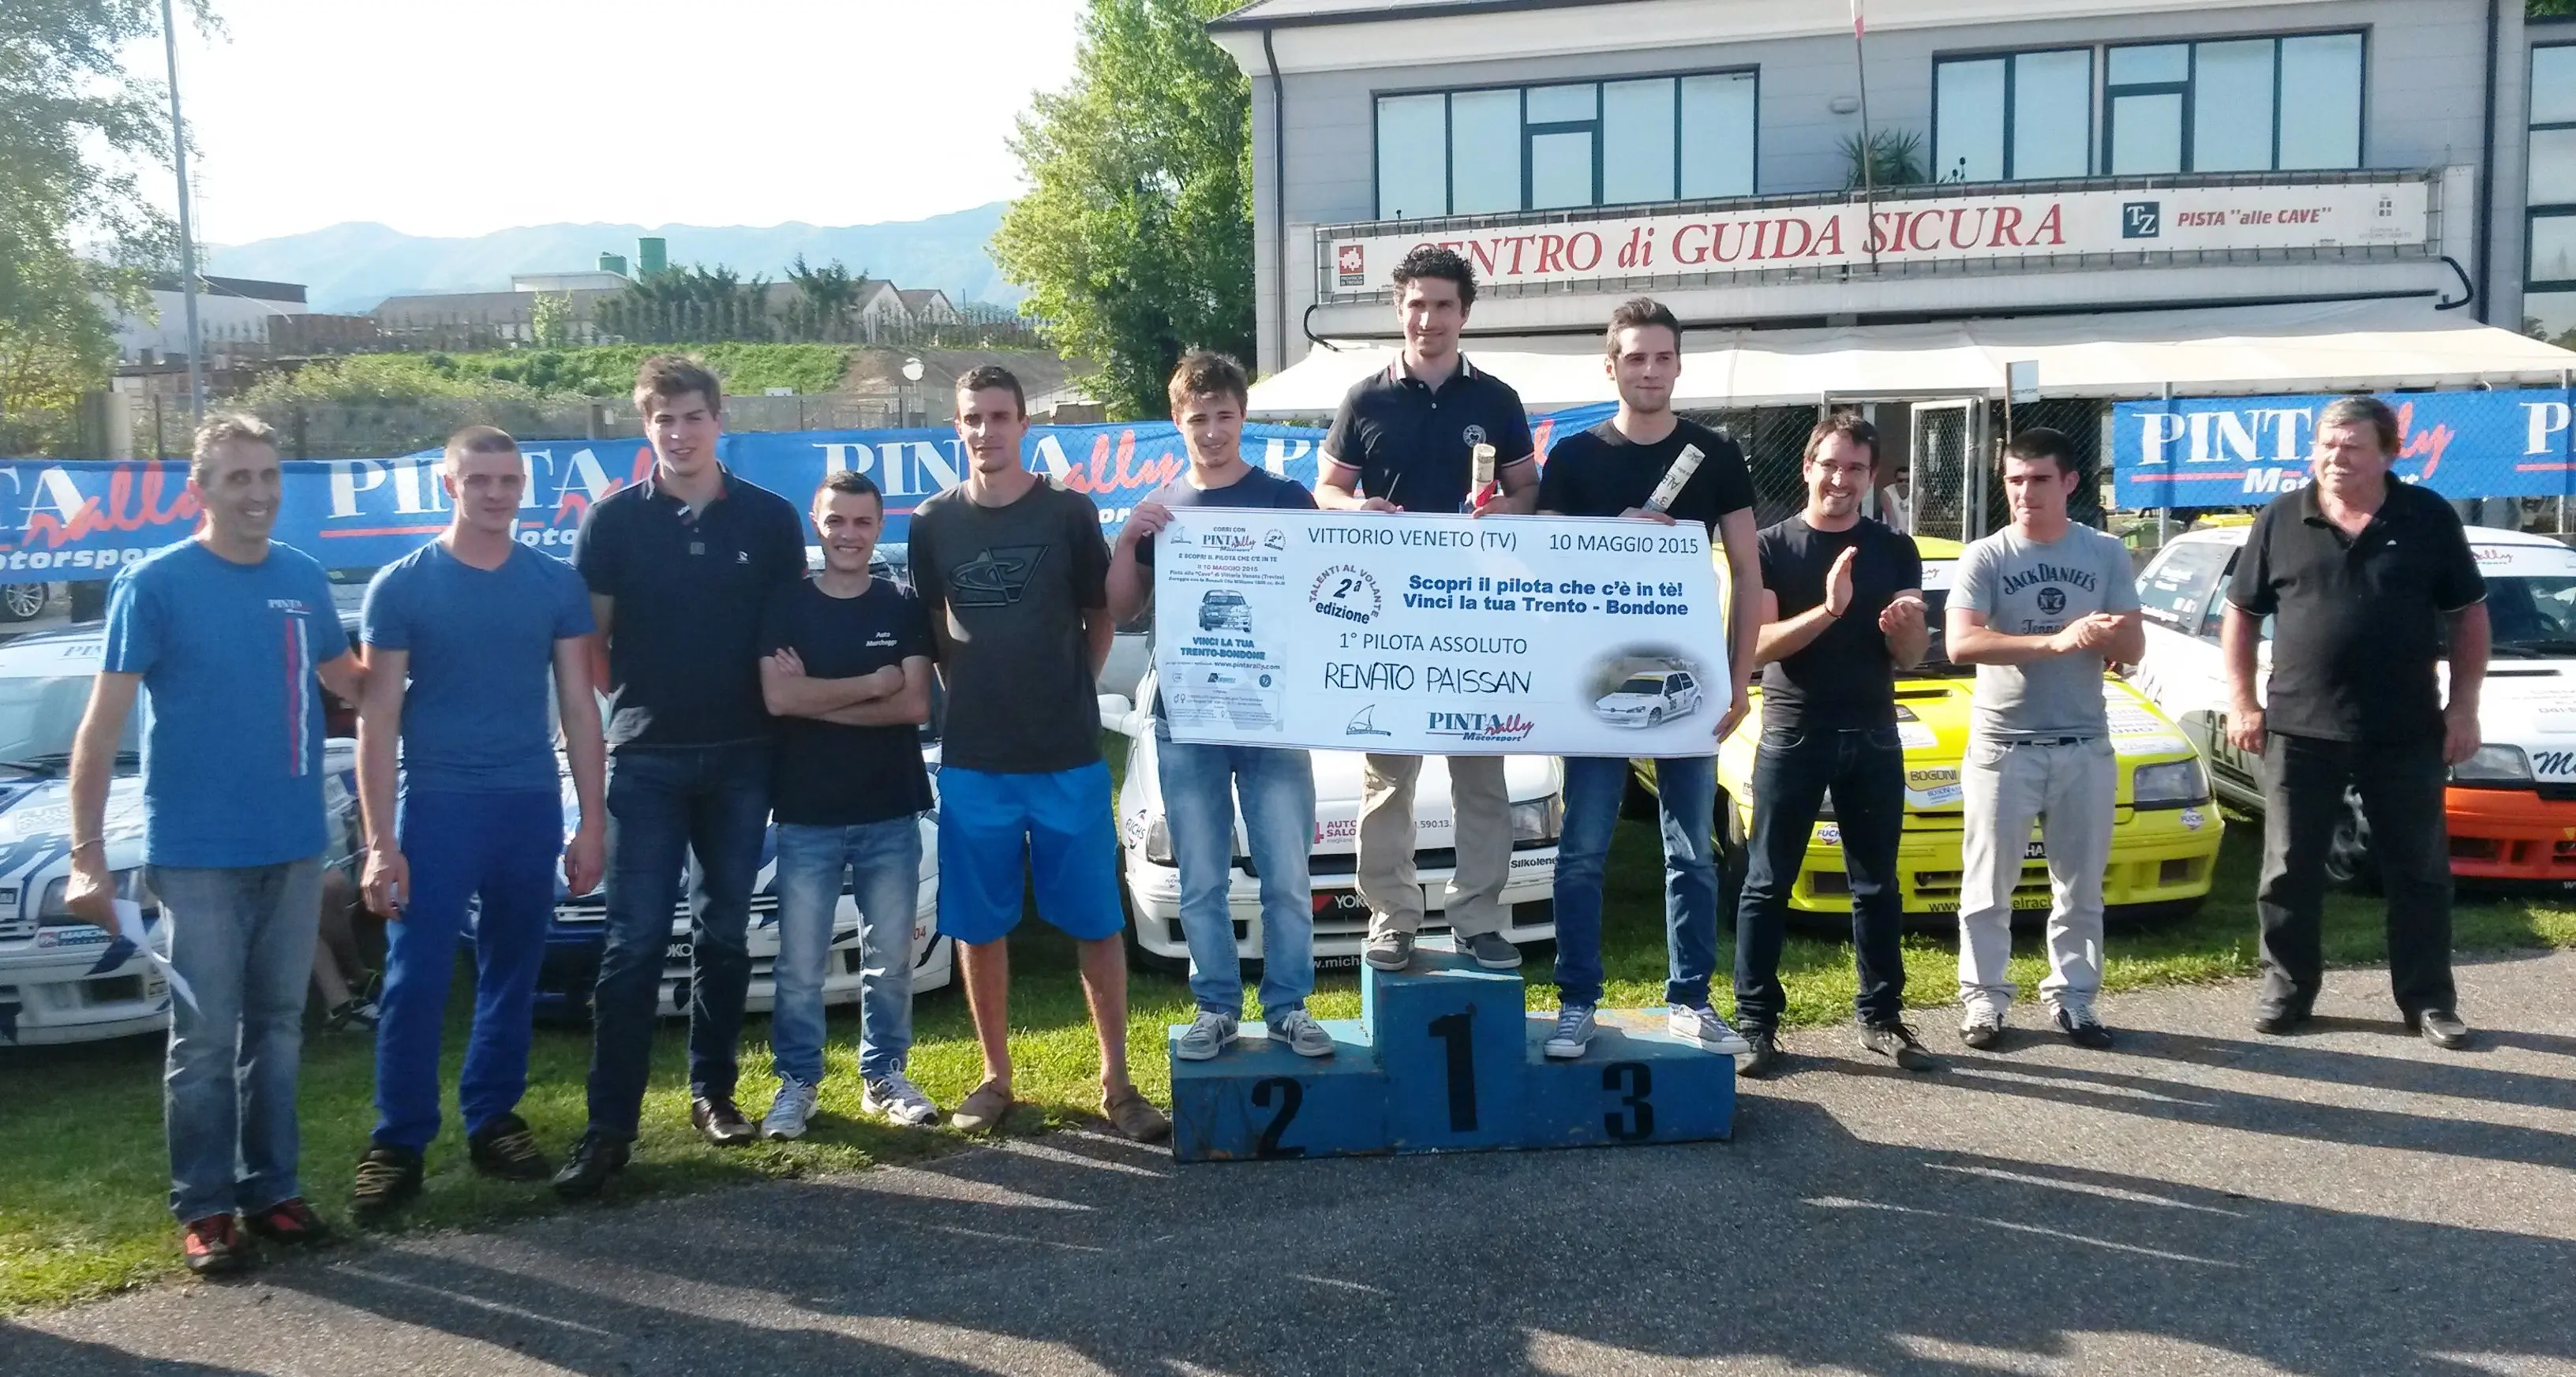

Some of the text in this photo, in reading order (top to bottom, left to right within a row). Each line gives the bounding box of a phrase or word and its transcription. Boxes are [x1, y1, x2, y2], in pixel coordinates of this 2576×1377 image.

[2177, 210, 2226, 227] PISTA
[1409, 203, 2066, 277] NTRO di GUIDA SICURA
[2132, 406, 2316, 466] PINT
[812, 434, 1076, 497] PINA
[1309, 528, 1698, 554] VITTORIO VENETO (TV) 10 MAGGIO 2015
[1309, 563, 1382, 618] TALENTI AL VOLANTE
[1409, 575, 1473, 593] Scopri
[1479, 577, 1490, 591] il
[1497, 578, 1553, 595] pilota
[1559, 580, 1596, 595] che
[1636, 582, 1654, 597] in
[1660, 582, 1683, 597] tè!
[2002, 568, 2039, 596] JACK
[1315, 601, 1370, 625] edizione
[1403, 593, 1453, 609] Vinci
[1459, 595, 1477, 610] la
[1485, 597, 1516, 611] tua
[1522, 597, 1587, 613] Trento
[1606, 600, 1688, 616] Bondone
[1181, 647, 1266, 660] TRENTO-BONDONE
[1193, 637, 1255, 648] VINCI LA TUA
[1339, 632, 1527, 654] 1° PILOTA ASSOLUTO
[1325, 662, 1531, 694] RENATO PAISSAN
[1426, 711, 1535, 738] PINTA rally
[1910, 769, 1957, 781] BOGONI
[1125, 818, 1147, 840] FUCHS
[1327, 829, 1357, 837] SALO
[1335, 894, 1368, 909] YOK
[1428, 1013, 1478, 1132] 1
[1602, 1062, 1655, 1142] 3
[1251, 1076, 1307, 1158] 2
